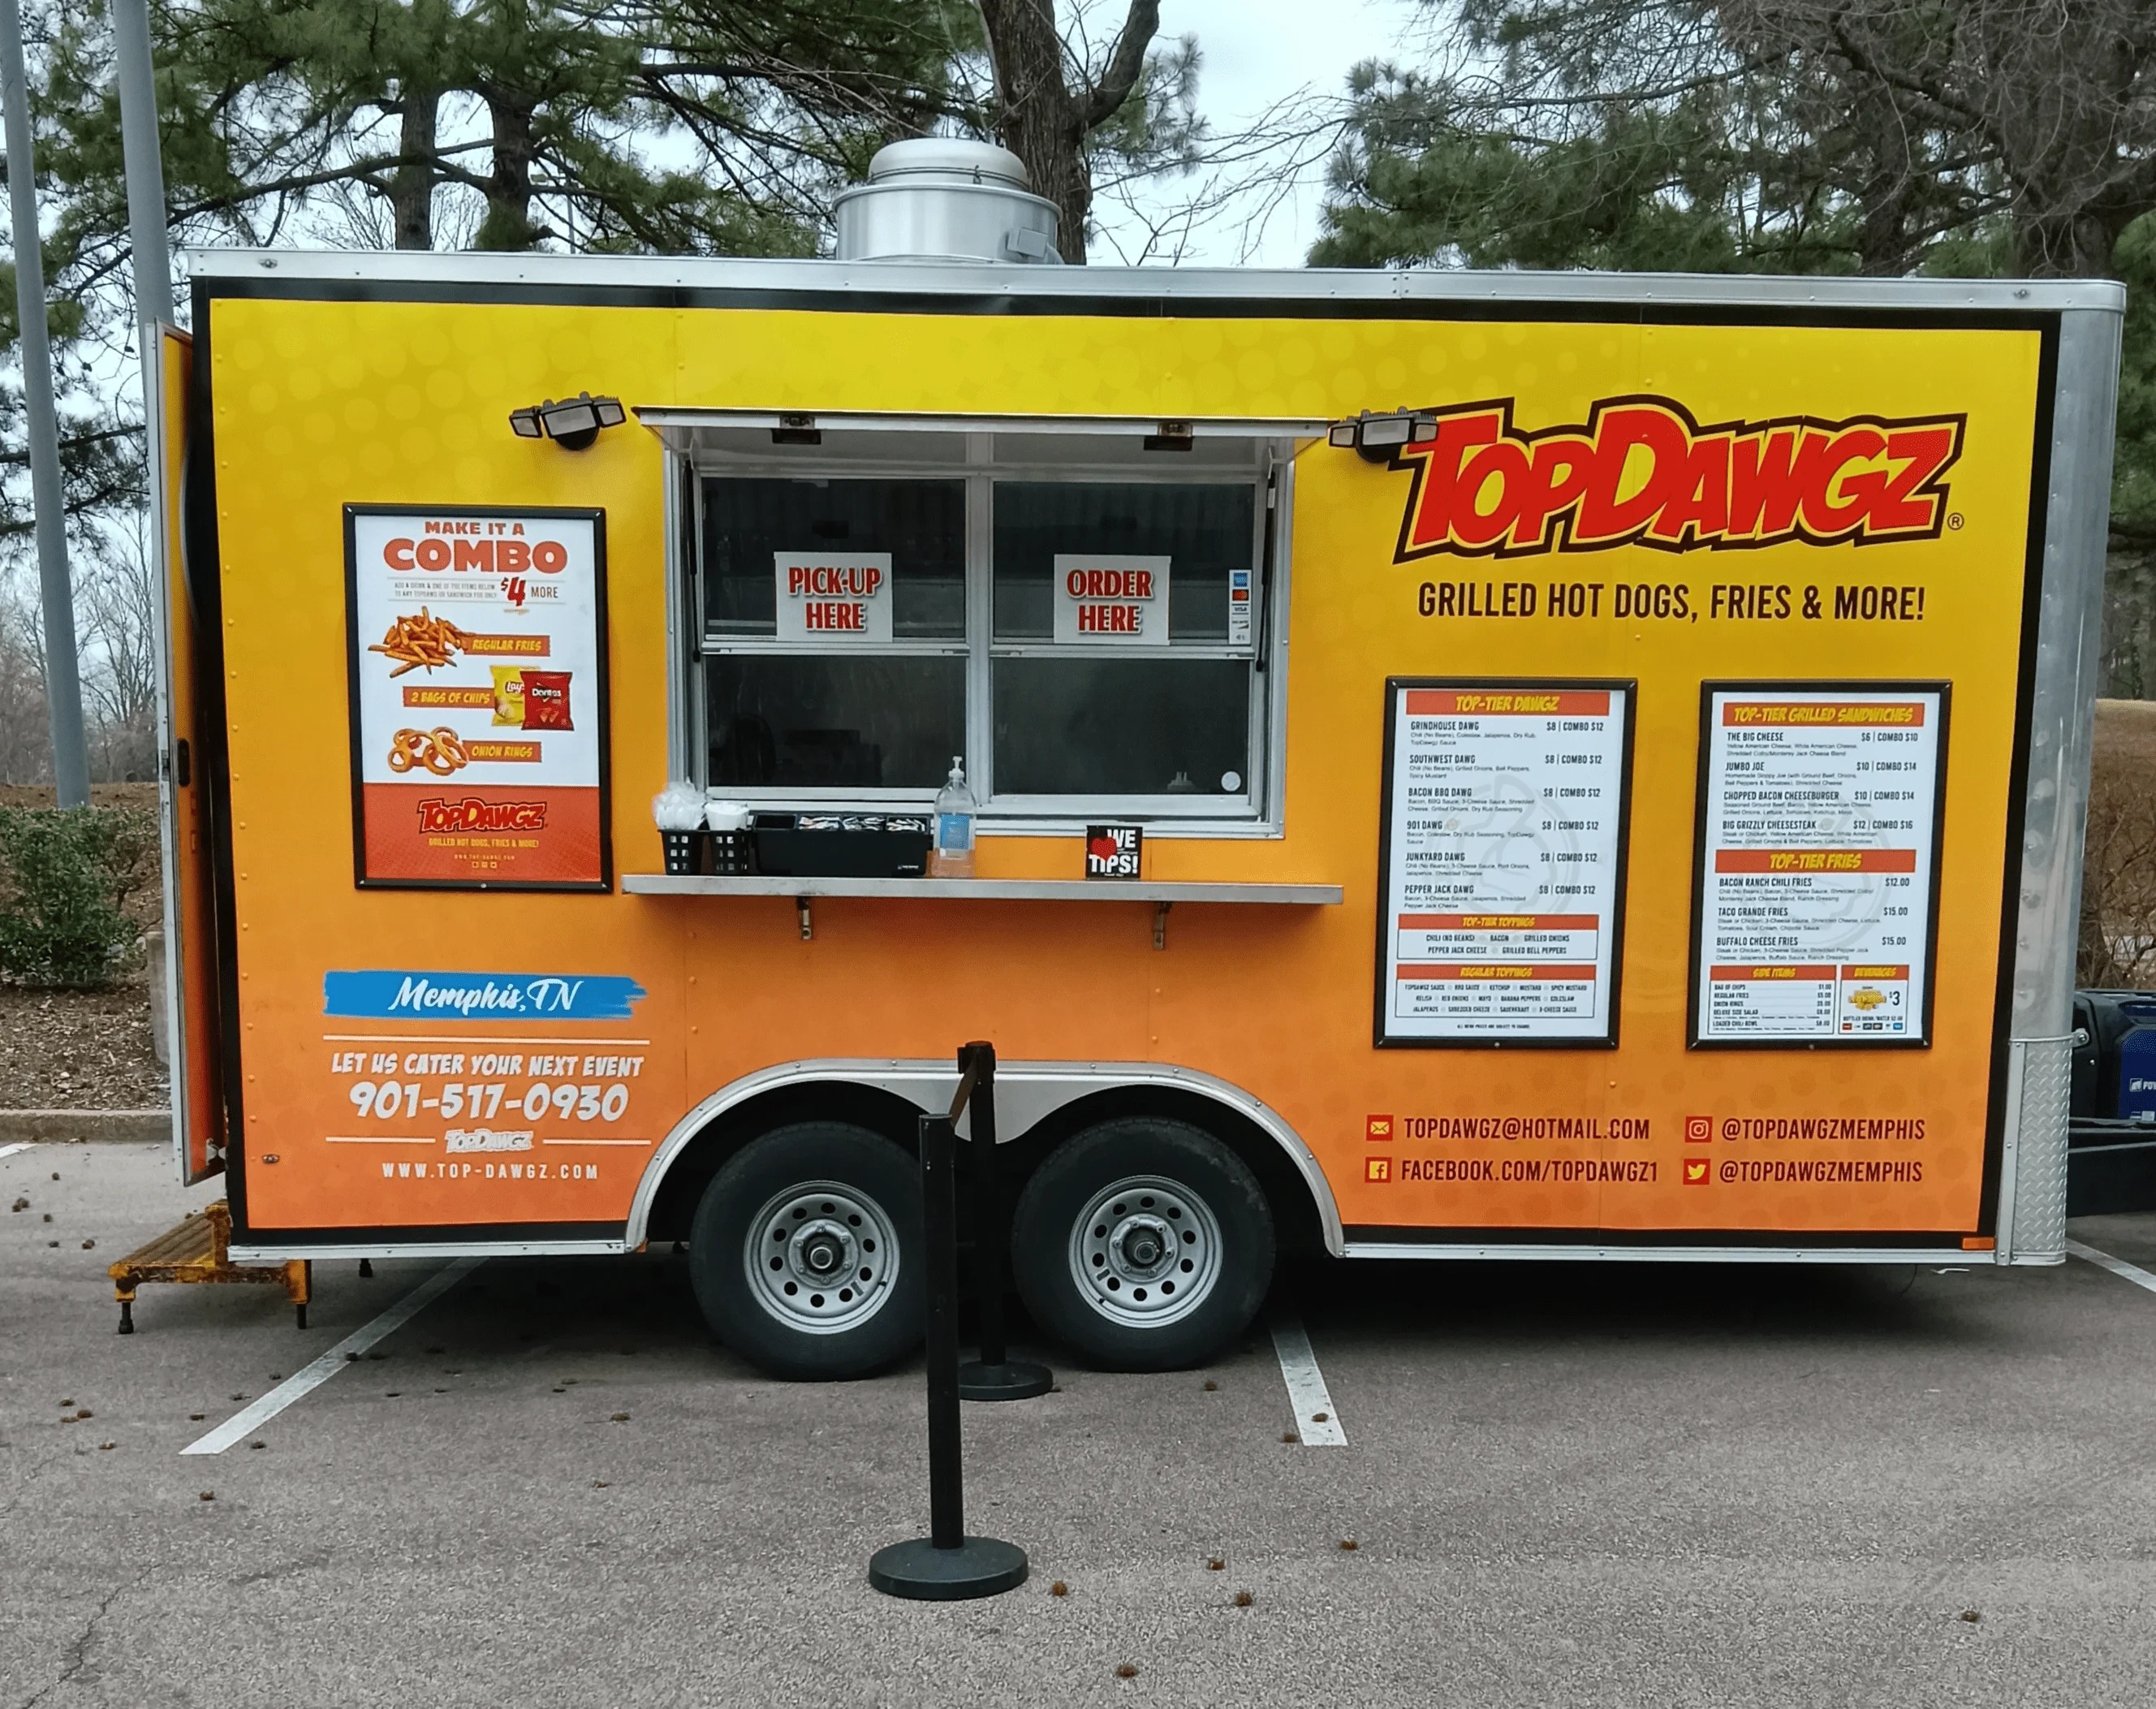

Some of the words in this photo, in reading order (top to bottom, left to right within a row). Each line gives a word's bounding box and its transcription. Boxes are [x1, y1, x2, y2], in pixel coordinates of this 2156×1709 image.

[425, 522, 481, 534] MAKE
[489, 523, 507, 534] IT
[512, 523, 524, 535] A
[384, 538, 567, 573] COMBO
[788, 567, 882, 596] PICK-UP
[1067, 569, 1153, 598] ORDER
[501, 576, 526, 606] $4
[531, 587, 558, 598] MORE
[1418, 582, 1537, 618] GRILLED
[1548, 583, 1604, 618] HOT
[1614, 584, 1698, 623] DOGS,
[1710, 585, 1791, 620] FRIES
[1801, 586, 1822, 619] &
[1834, 586, 1925, 621] MORE!
[805, 602, 867, 632] HERE
[1078, 605, 1141, 633] HERE
[472, 640, 514, 650] REGULAR
[516, 641, 542, 651] FRIES
[532, 688, 562, 697] Doritos
[412, 693, 418, 701] 2
[421, 693, 446, 702] BAGS
[449, 693, 461, 702] OF
[464, 693, 490, 704] CHIPS
[1455, 696, 1511, 711] TOP-TIER
[1514, 696, 1560, 712] DAWGZ
[1734, 708, 1787, 722] TOP-TIER
[1789, 707, 1835, 722] GRILLED
[1838, 708, 1912, 723] SANDWICHES
[1411, 722, 1456, 731] GRINDHOUSE
[1459, 722, 1479, 731] DAWG
[1563, 723, 1589, 731] COMBO
[1727, 732, 1740, 741] THE
[1743, 732, 1755, 741] BIG
[1757, 732, 1783, 741] CHEESE
[1878, 733, 1903, 742] COMBO
[472, 746, 503, 757] ONION
[504, 746, 533, 757] RINGS
[1410, 755, 1452, 763] SOUTHWEST
[1455, 755, 1475, 763] DAWG
[1562, 755, 1586, 764] COMBO
[1726, 762, 1750, 770] JUMBO
[1752, 762, 1764, 770] JOE
[1876, 762, 1901, 771] COMBO
[1408, 788, 1432, 797] BACON
[1435, 788, 1450, 797] BBQ
[1451, 788, 1472, 797] DAWG
[1560, 788, 1585, 797] COMBO
[1723, 792, 1757, 800] CHOPPED
[1759, 792, 1783, 800] BACON
[1785, 792, 1839, 801] CHEESEBURGER
[1874, 792, 1899, 801] COMBO
[1408, 821, 1420, 830] 901
[1422, 821, 1442, 830] DAWG
[1559, 822, 1584, 830] COMBO
[1723, 821, 1735, 829] BIG
[1737, 821, 1765, 830] GRIZZLY
[1767, 821, 1816, 830] CHEESESTEAK
[1873, 821, 1898, 829] COMBO
[1107, 829, 1136, 848] WE
[1406, 852, 1442, 861] JUNKYARD
[1444, 852, 1464, 861] DAWG
[1557, 853, 1582, 862] COMBO
[1089, 854, 1138, 874] TIPS!
[1770, 854, 1824, 869] TOP-TIER
[1827, 854, 1861, 869] FRIES
[1719, 878, 1743, 887] BACON
[1745, 878, 1769, 887] RANCH
[1771, 878, 1790, 887] CHILI
[1792, 878, 1812, 887] FRIES
[1886, 878, 1909, 887] $12.00
[1404, 885, 1432, 894] PEPPER
[1434, 885, 1451, 894] JACK
[1453, 885, 1474, 894] DAWG
[1555, 886, 1580, 895] COMBO
[1718, 908, 1736, 916] TACO
[1738, 908, 1766, 916] GRANDE
[1768, 908, 1788, 916] FRIES
[1883, 907, 1908, 916] $15.00
[1463, 917, 1497, 926] TOP-TIER
[1717, 937, 1747, 946] BUFFALO
[1750, 937, 1776, 946] CHEESE
[1778, 937, 1798, 946] FRIES
[1882, 937, 1906, 945] $15.00
[388, 977, 526, 1016] Memphis,
[527, 978, 584, 1011] TN
[332, 1053, 367, 1073] LET
[372, 1054, 397, 1073] US
[404, 1055, 464, 1075] CATER
[471, 1055, 522, 1075] YOUR
[528, 1055, 578, 1077] NEXT
[583, 1056, 644, 1077] EVENT
[350, 1081, 628, 1121] 901-517-0930
[1404, 1119, 1649, 1141] TOPDAWGZ@HOTMAIL.COM
[1722, 1119, 1925, 1141] @TOPDAWGZMEMPHIS
[382, 1163, 597, 1180] WWW.TOP-DAWGZ.COM
[1401, 1160, 1658, 1182] FACEBOOK.COM/TOPDAWGZ1
[1719, 1160, 1923, 1184] @TOPDAWGZMEMPHIS
